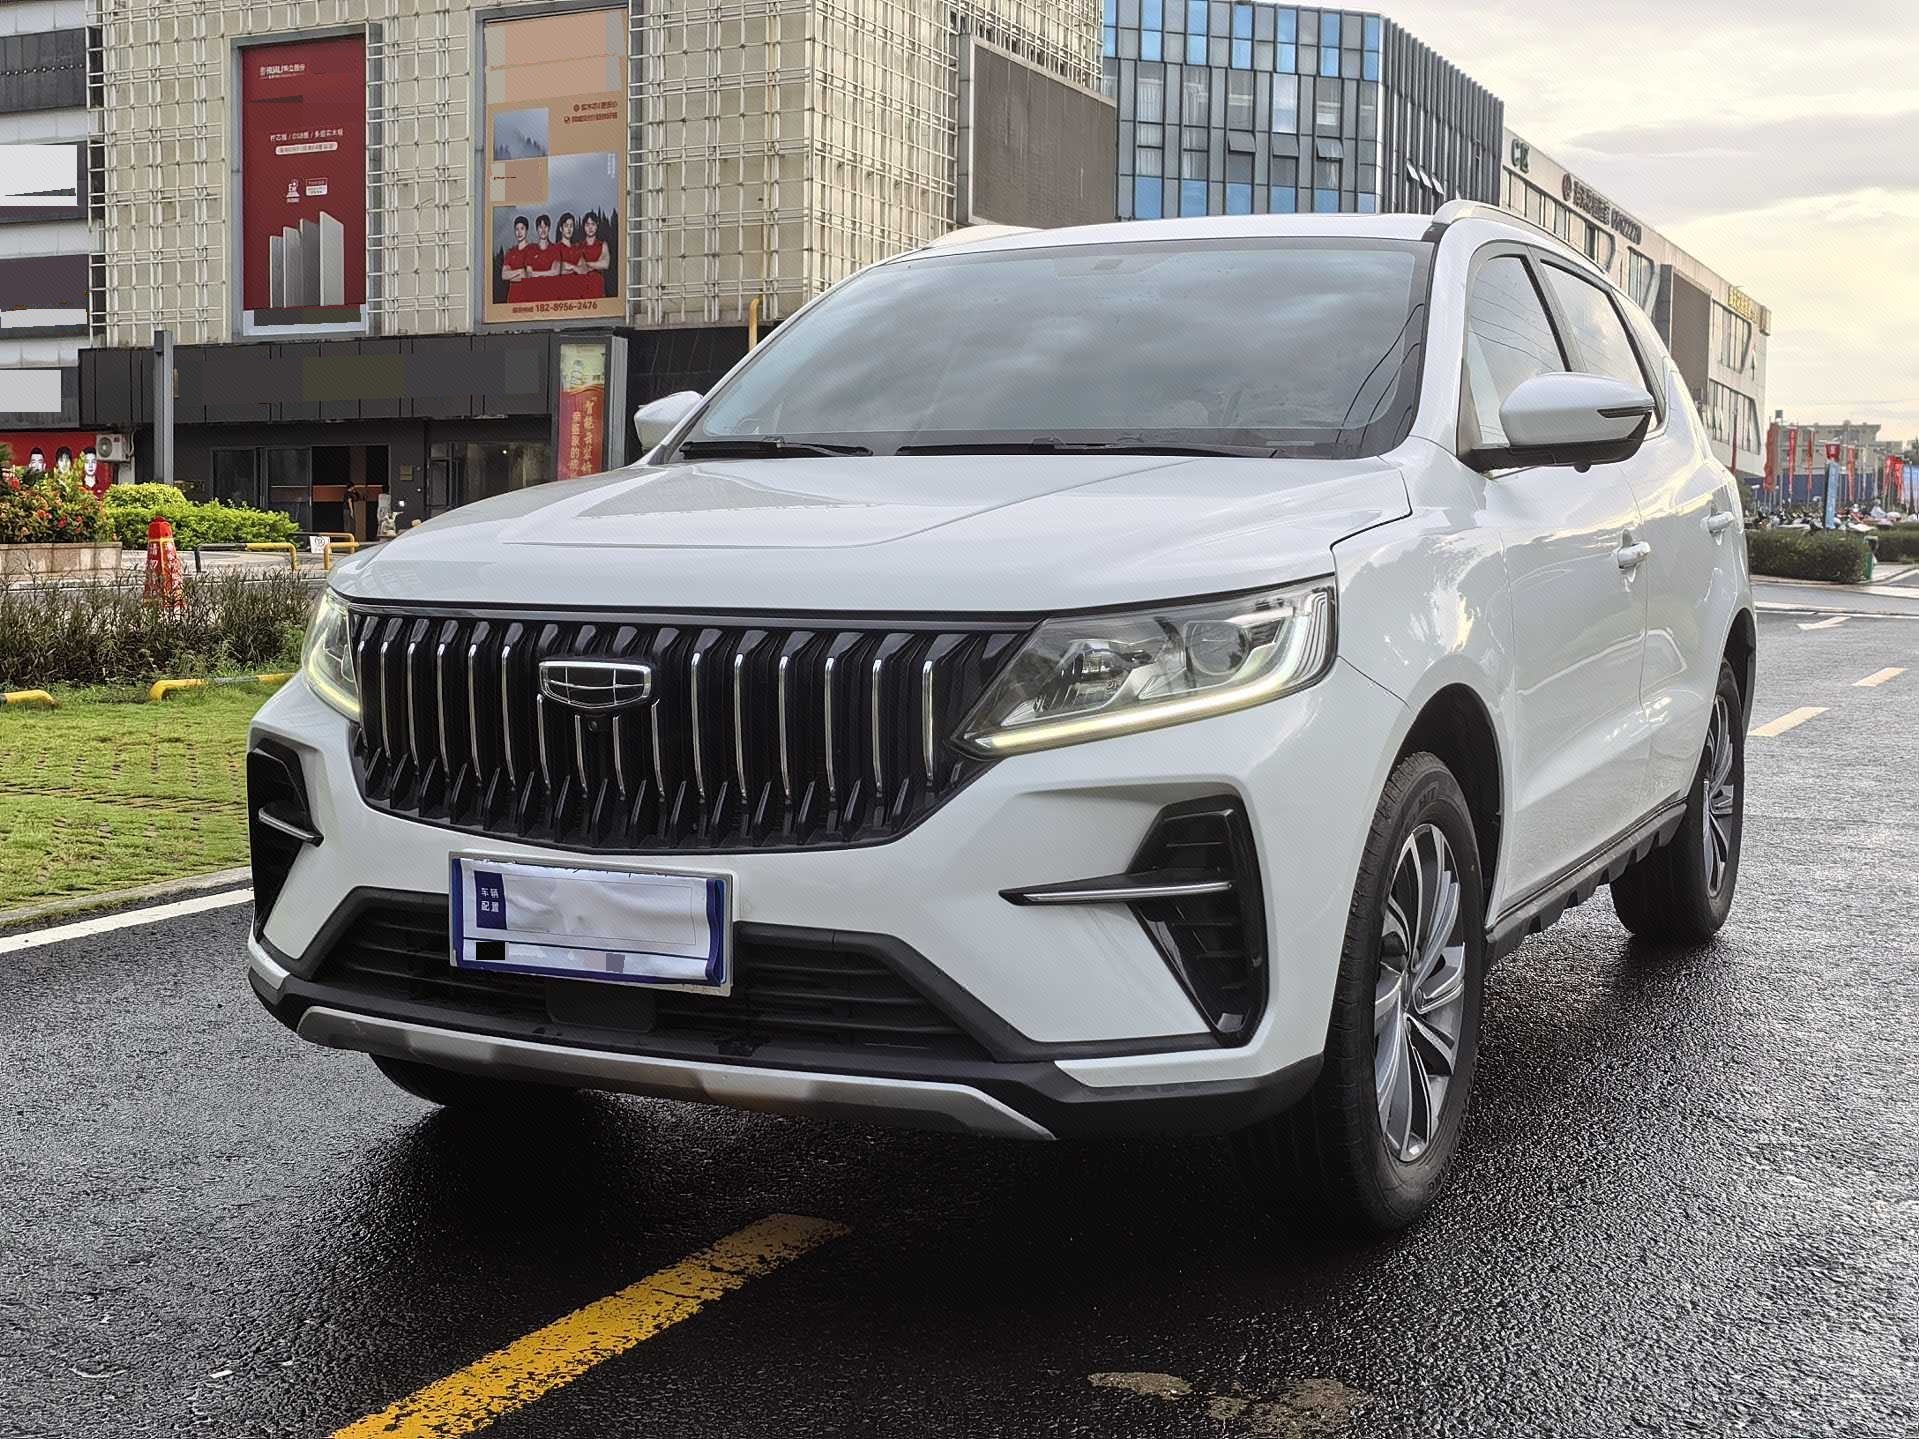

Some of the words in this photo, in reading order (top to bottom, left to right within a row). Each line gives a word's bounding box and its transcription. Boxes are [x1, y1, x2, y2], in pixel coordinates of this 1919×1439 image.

[535, 301, 598, 313] 182-8956-2476
[481, 887, 499, 899] 车辆
[481, 900, 499, 912] 配置
